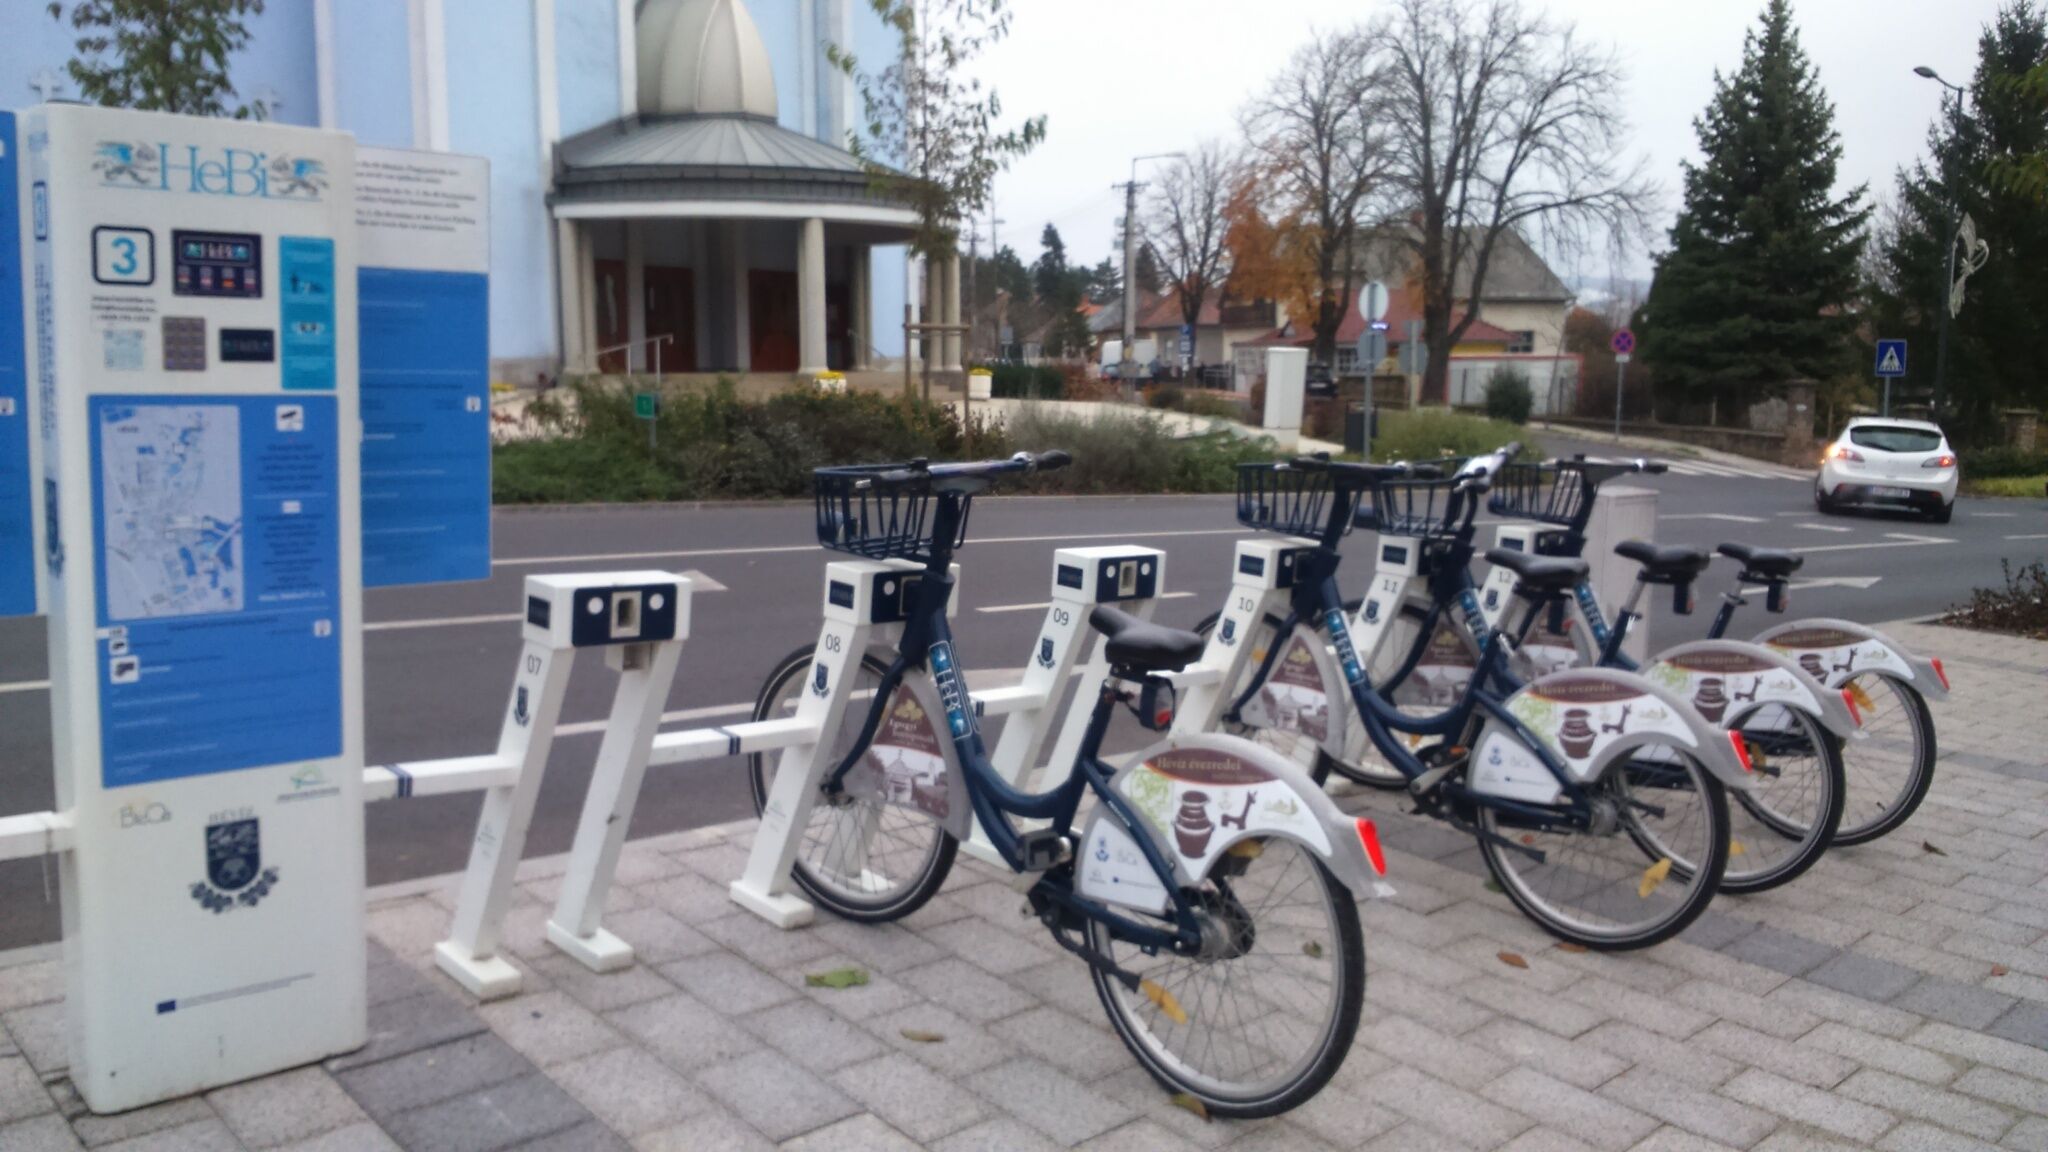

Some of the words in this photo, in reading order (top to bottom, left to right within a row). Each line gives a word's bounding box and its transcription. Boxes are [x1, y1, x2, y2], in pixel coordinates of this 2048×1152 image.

[158, 142, 268, 197] HeBi
[111, 236, 138, 275] 3
[1383, 579, 1398, 594] 11
[1238, 596, 1255, 613] 10
[1053, 607, 1070, 626] 09
[825, 633, 841, 653] 08
[527, 654, 542, 675] 07
[936, 668, 962, 712] HeBi
